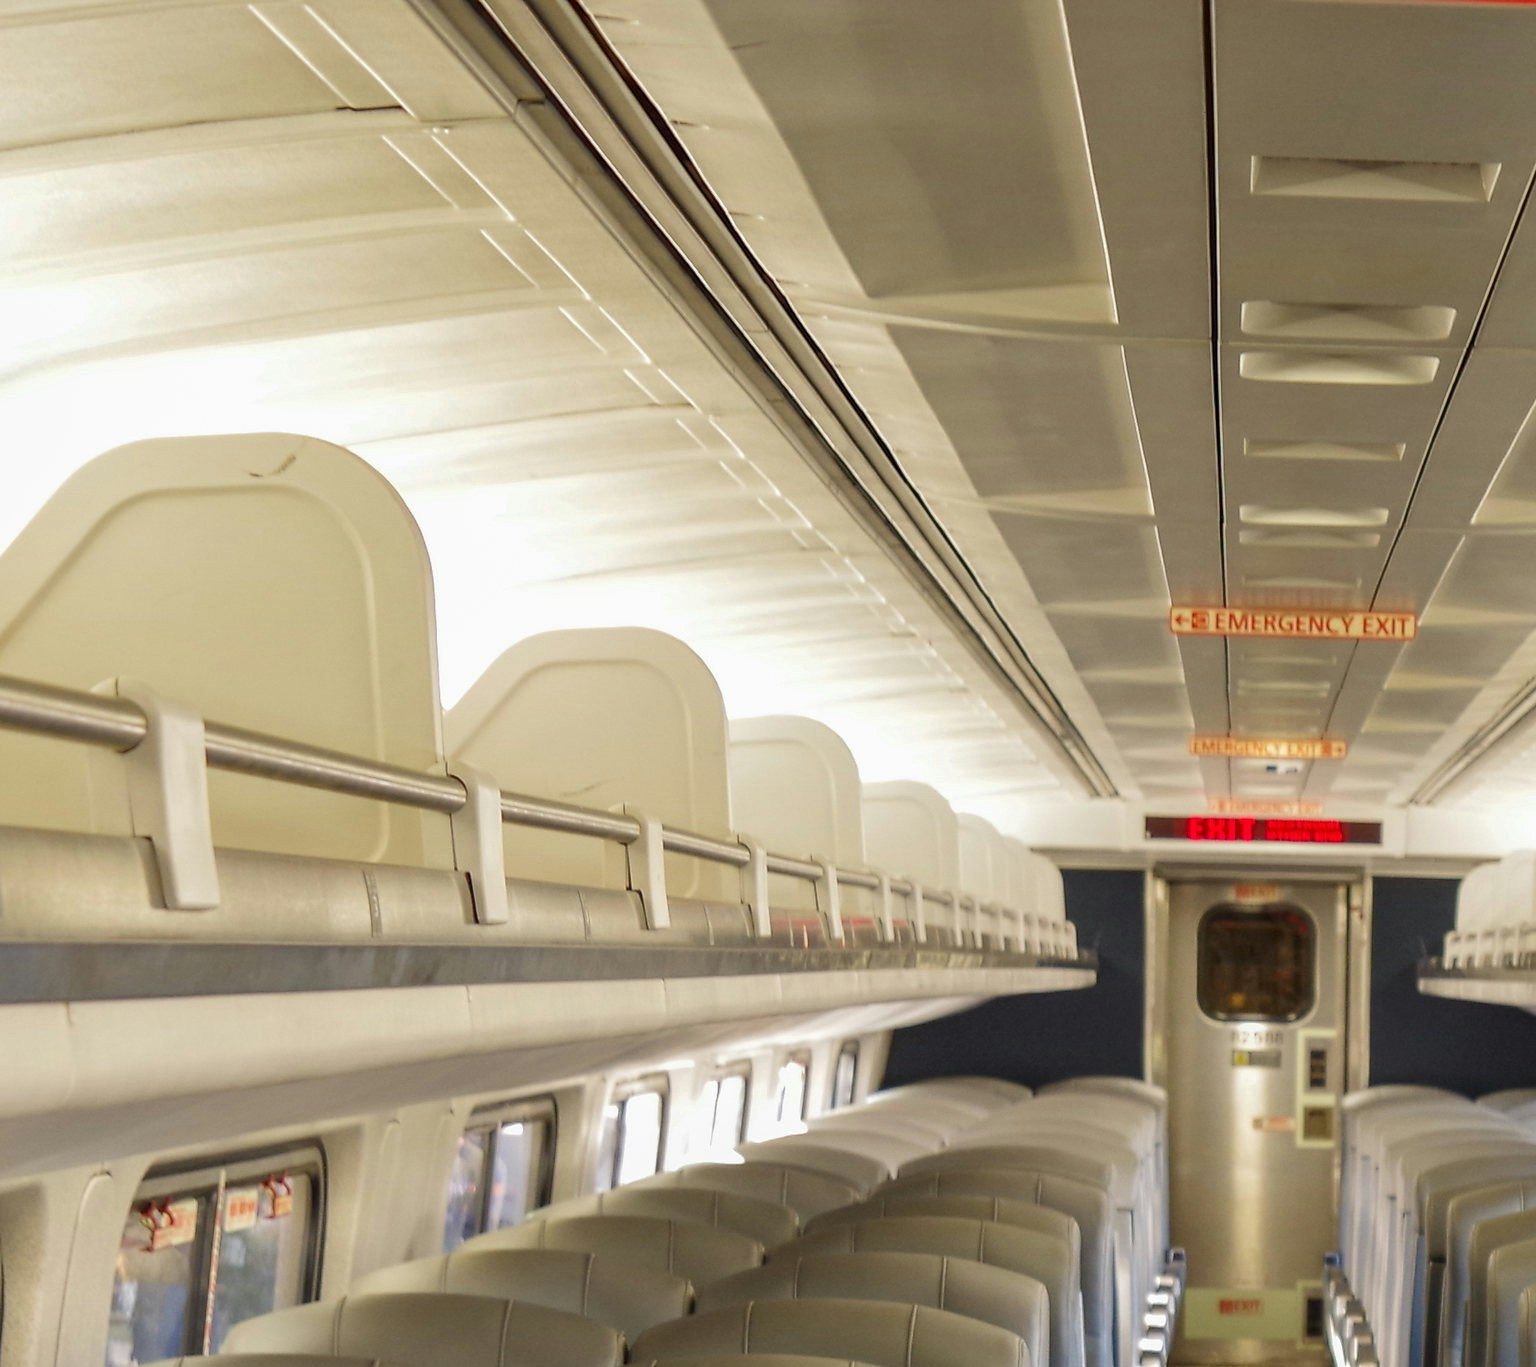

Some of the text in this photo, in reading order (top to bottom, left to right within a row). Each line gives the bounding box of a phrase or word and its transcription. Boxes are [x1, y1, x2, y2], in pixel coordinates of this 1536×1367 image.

[1215, 611, 1410, 636] EMERGENCY EXIT
[1193, 739, 1281, 756] EMERGENCY
[1187, 817, 1255, 841] EXIT
[1232, 1299, 1261, 1311] EXIT
